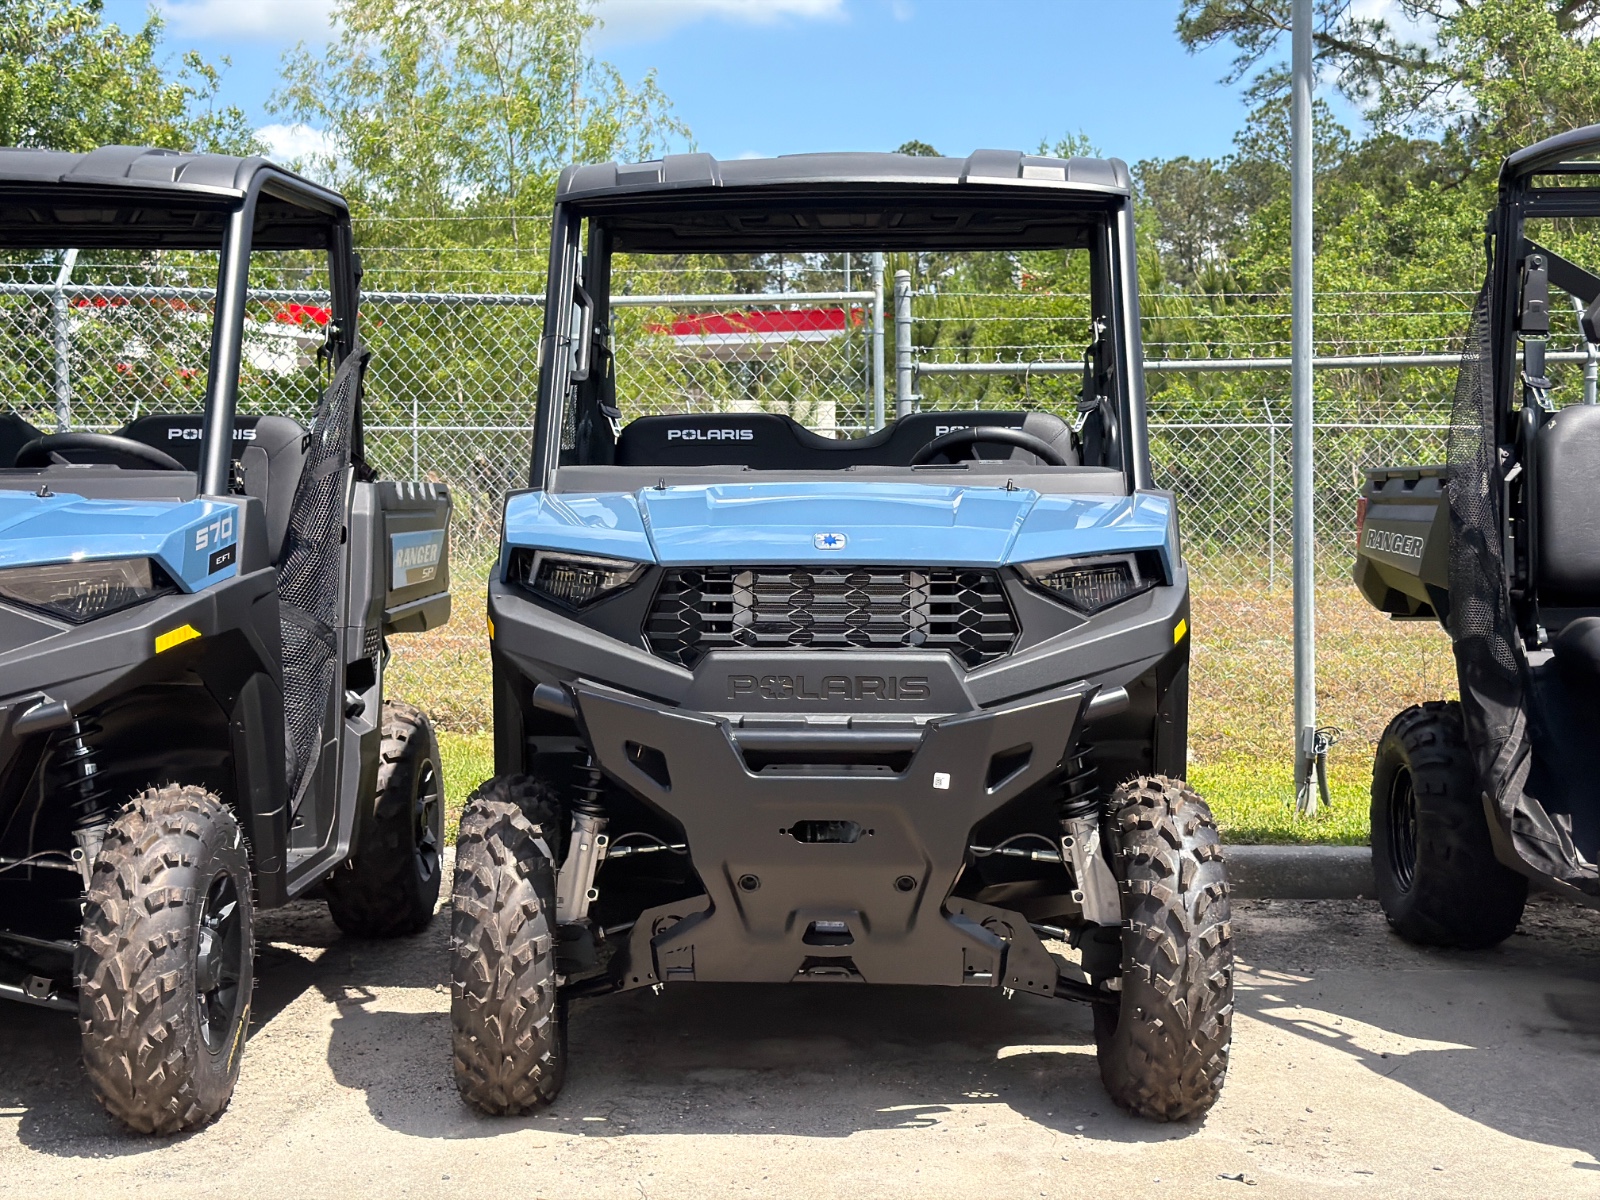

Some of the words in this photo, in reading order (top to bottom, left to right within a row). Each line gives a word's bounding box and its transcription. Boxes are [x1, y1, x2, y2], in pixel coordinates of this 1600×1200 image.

[168, 428, 257, 440] POLIS
[667, 429, 754, 440] POLARIS
[195, 516, 233, 551] 570
[1365, 528, 1424, 558] RANGER
[216, 552, 231, 565] EFI
[396, 543, 438, 568] RANGER
[421, 566, 434, 579] SP
[727, 675, 931, 701] POLARIS
